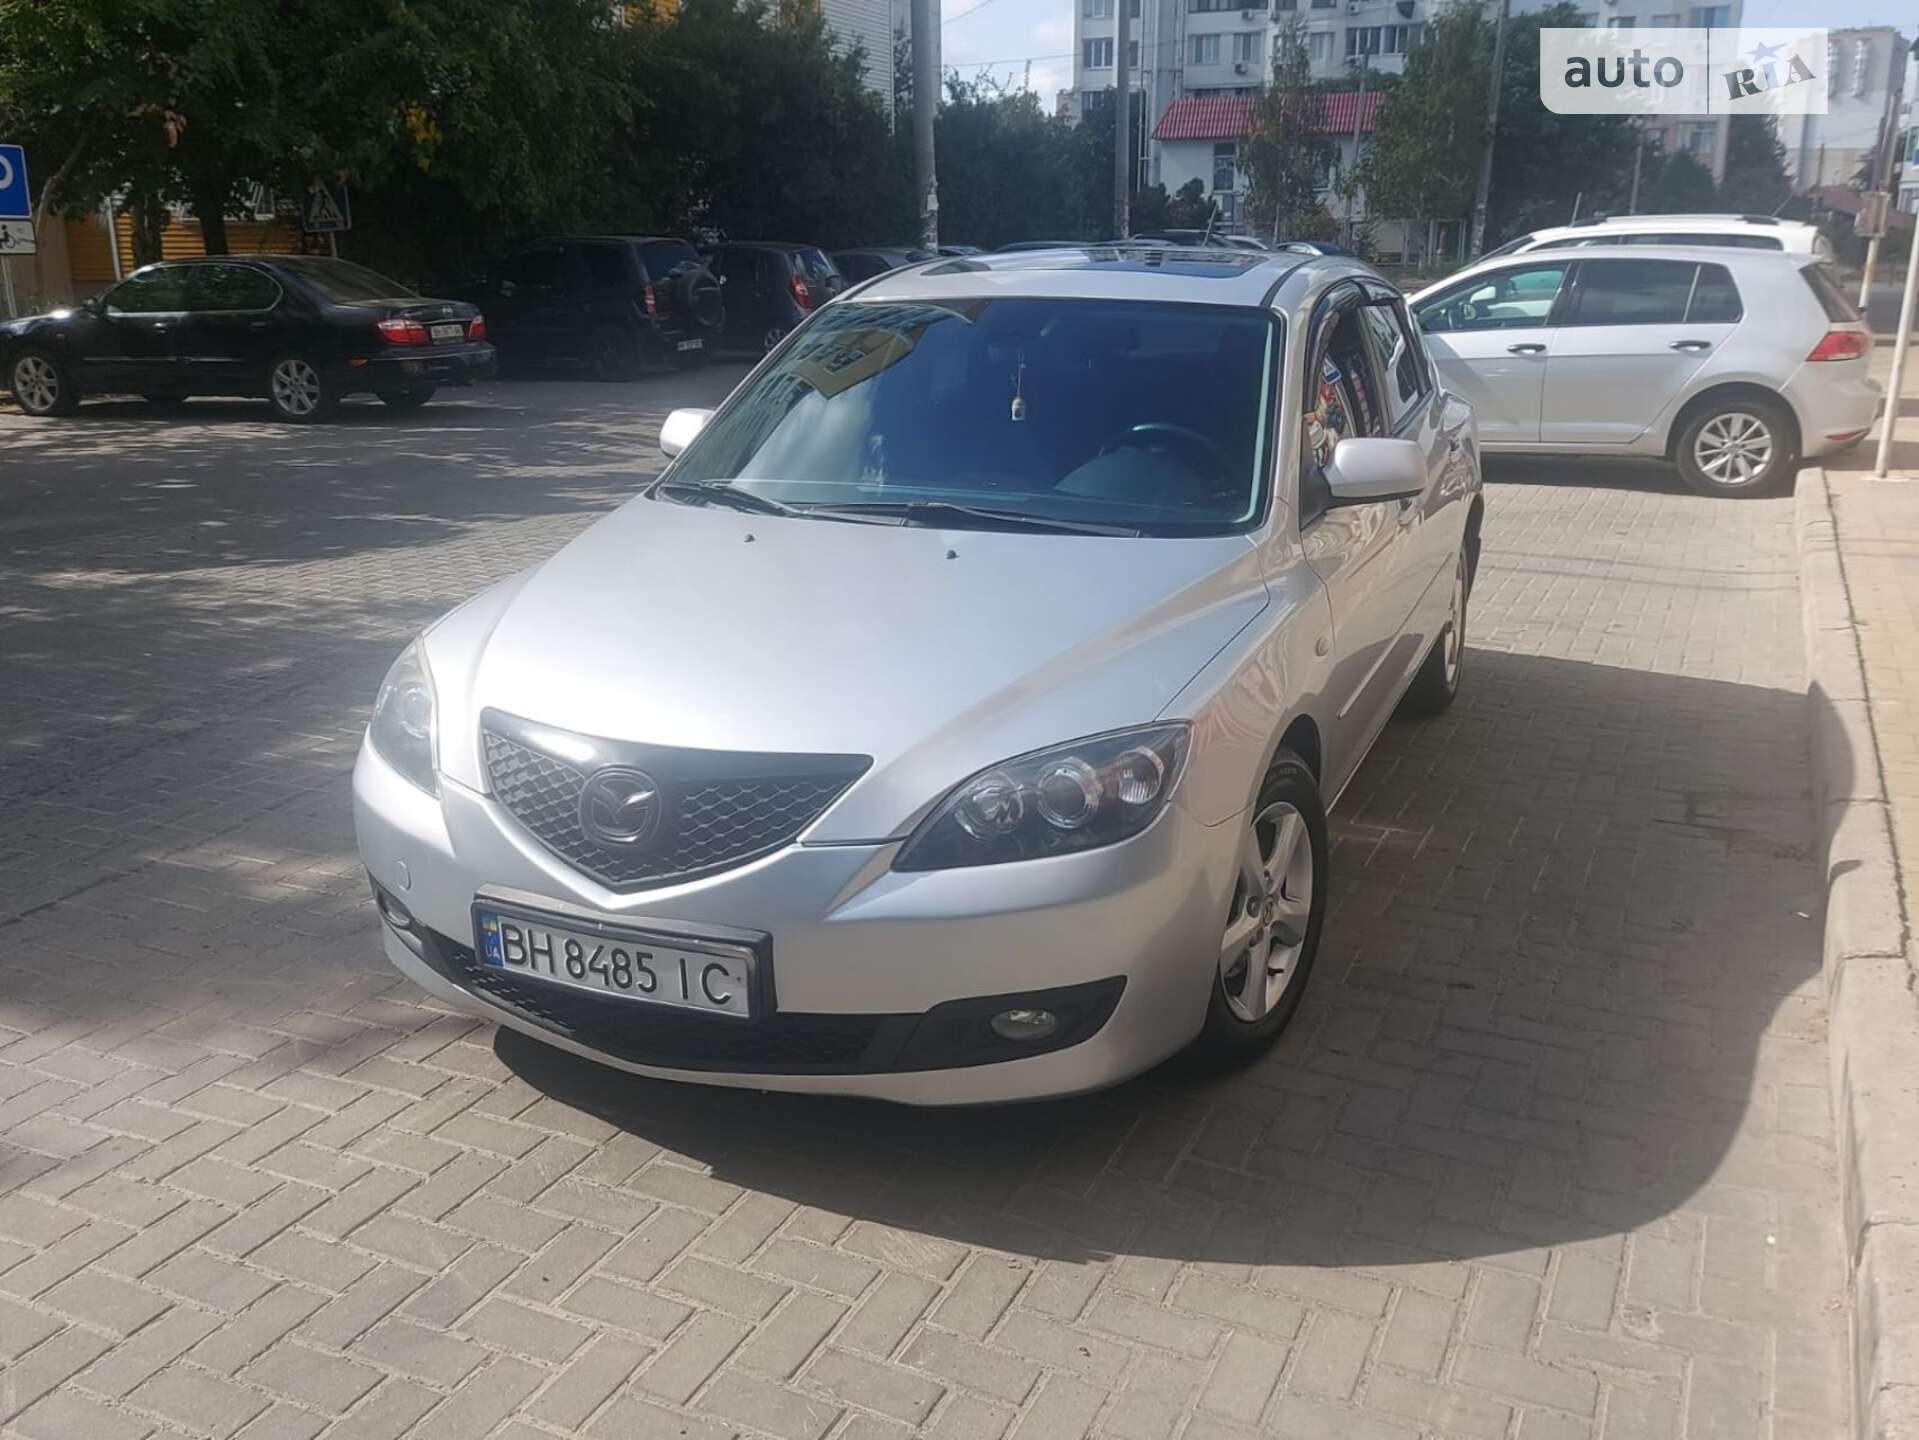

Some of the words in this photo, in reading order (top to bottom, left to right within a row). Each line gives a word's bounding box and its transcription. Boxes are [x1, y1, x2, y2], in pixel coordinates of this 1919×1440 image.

[484, 943, 501, 960] UA
[501, 923, 555, 974] BH
[564, 938, 657, 993] 8485
[680, 957, 732, 1006] IC
